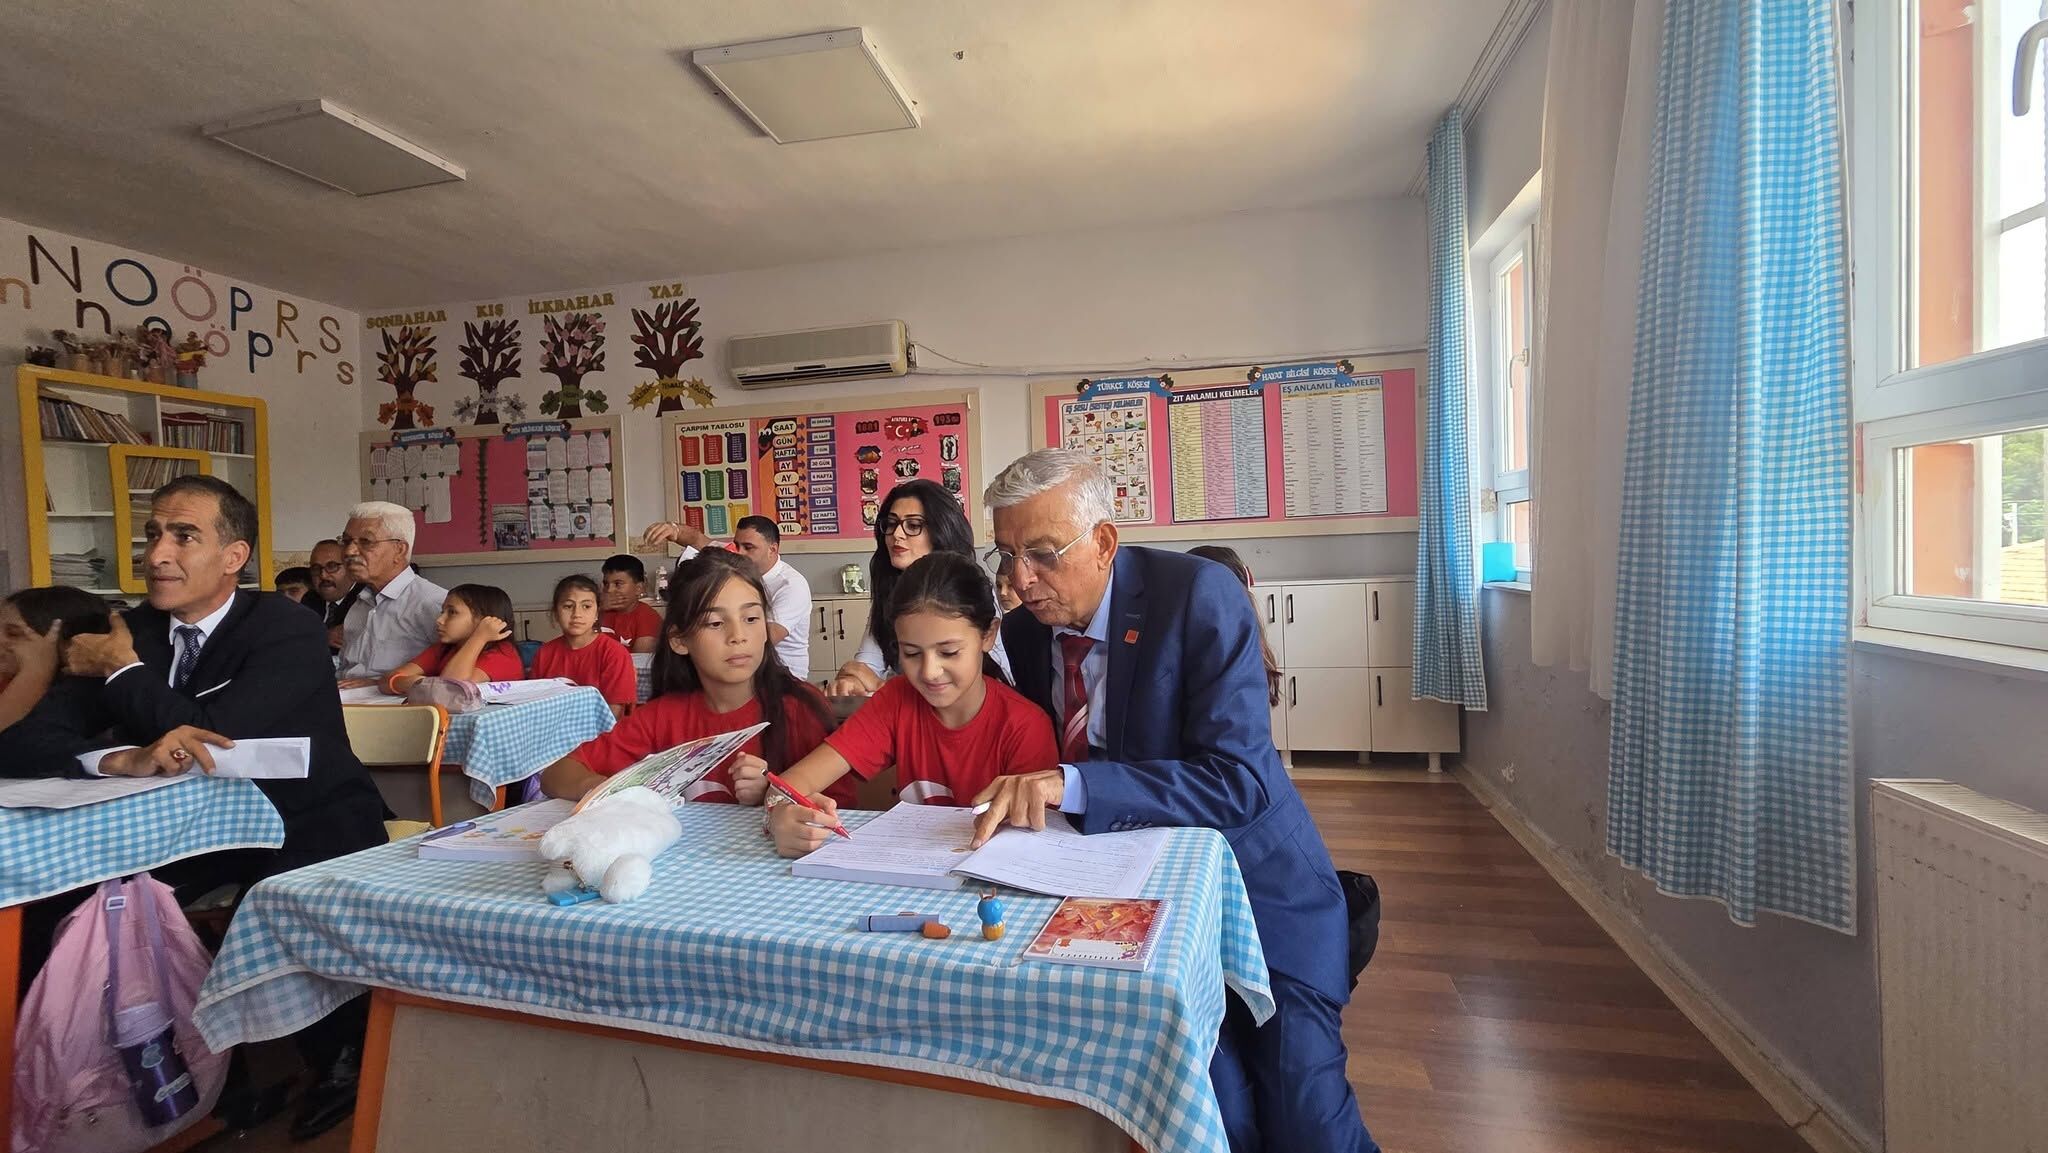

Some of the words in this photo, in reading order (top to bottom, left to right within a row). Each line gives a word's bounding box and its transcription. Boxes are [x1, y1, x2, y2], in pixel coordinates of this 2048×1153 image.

[28, 234, 82, 293] N
[105, 258, 158, 307] O
[171, 265, 217, 322] Ö
[230, 286, 253, 331] P
[276, 300, 299, 344] R
[319, 316, 341, 353] S
[649, 283, 684, 299] YAZ
[528, 292, 615, 315] İLKBAHAR
[476, 303, 504, 318] KIŞ
[366, 310, 447, 329] SONBAHAR
[76, 299, 111, 335] n
[248, 330, 273, 373] p
[297, 349, 317, 374] r
[336, 361, 354, 385] s
[1262, 371, 1283, 381] HAYAT
[1097, 381, 1124, 391] TÜRKÇE
[1294, 382, 1332, 392] ANLAMLI
[1172, 394, 1184, 402] ZIT
[1185, 391, 1218, 401] ANLAMLI
[1219, 388, 1259, 398] KELİMELER
[681, 424, 709, 433] ÇARPIM
[711, 422, 745, 430] TABLOSU
[774, 423, 794, 432] SAAT
[776, 436, 793, 446] GÜN
[774, 449, 796, 457] HAFTA
[781, 462, 791, 470] AY
[781, 474, 792, 483] AY
[780, 487, 793, 495] YIL
[780, 499, 794, 508] YIL
[781, 512, 794, 520] YIL
[781, 524, 795, 533] YIL
